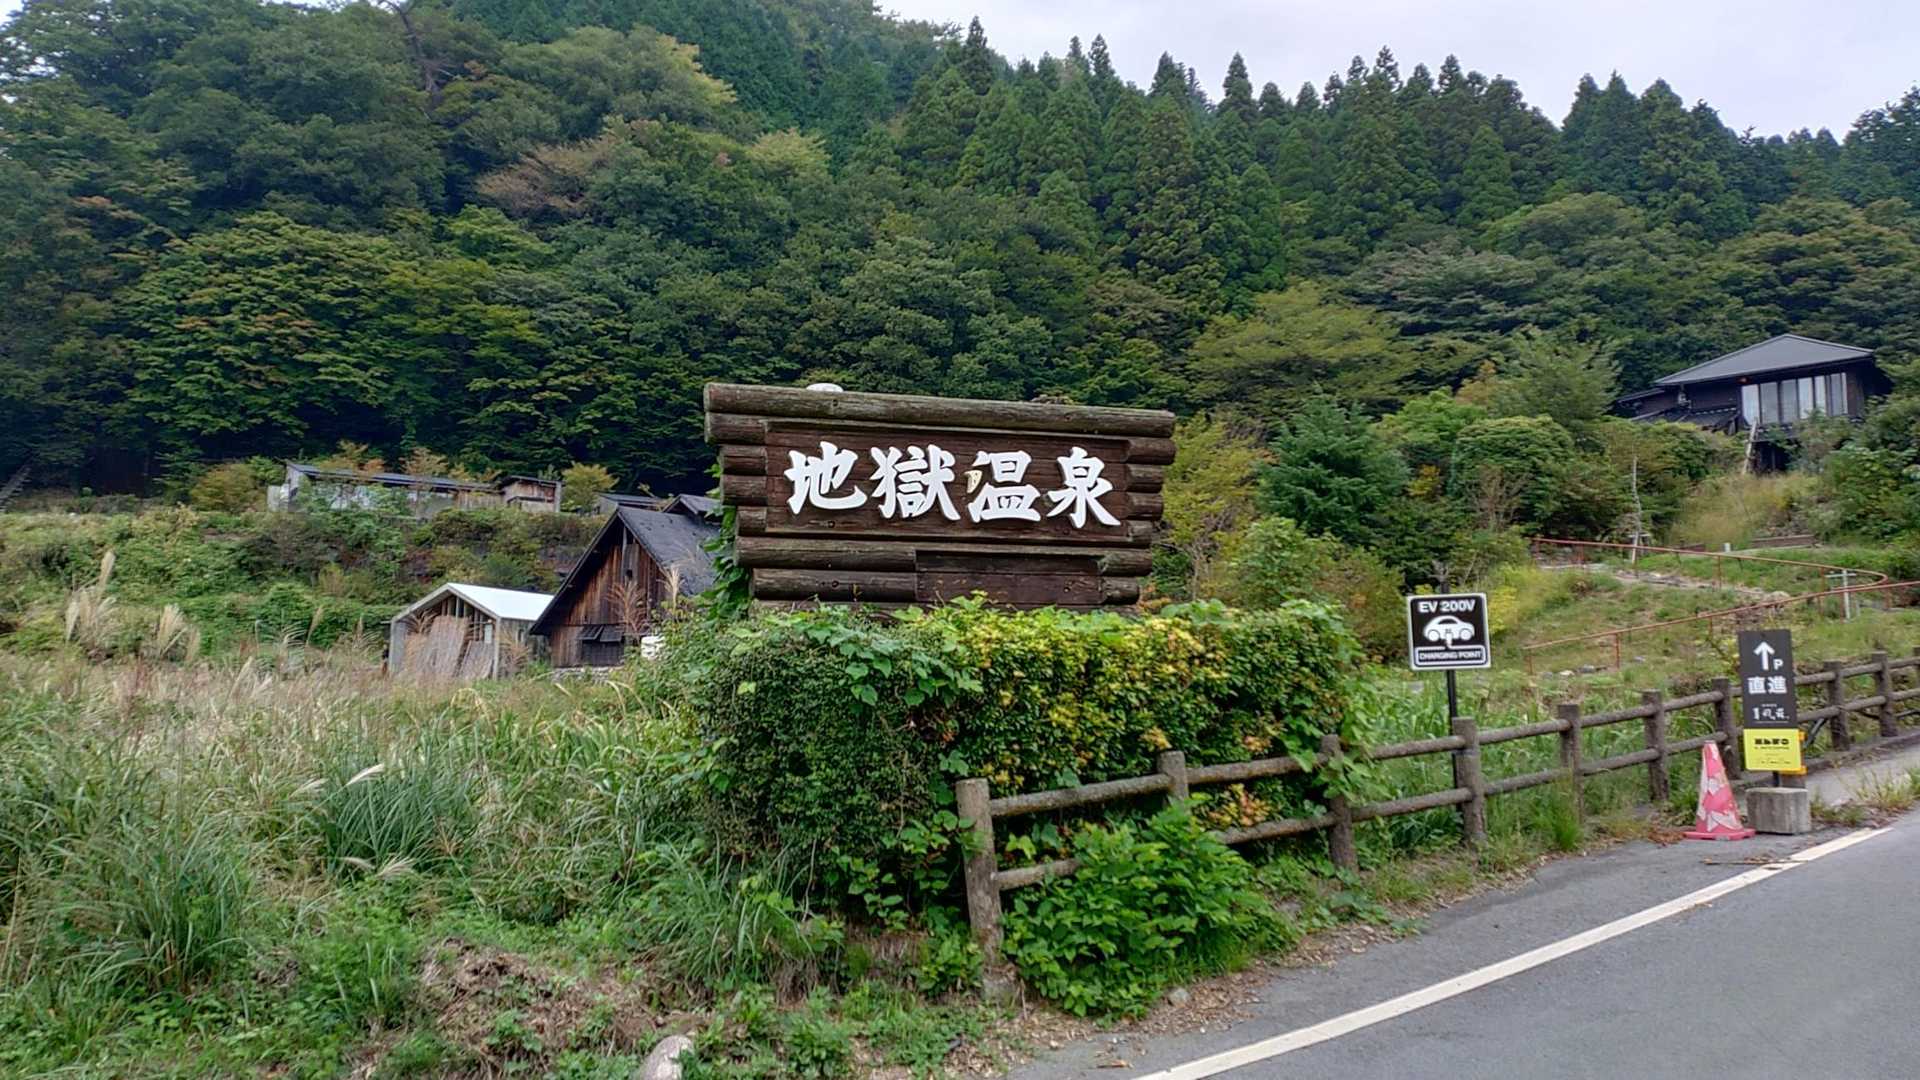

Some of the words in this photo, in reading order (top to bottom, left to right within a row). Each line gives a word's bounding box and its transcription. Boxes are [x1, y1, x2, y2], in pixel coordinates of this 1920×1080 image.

[784, 441, 1121, 529] 地獄温泉
[1418, 601, 1438, 613] EV
[1440, 599, 1476, 612] 200V
[1458, 650, 1482, 659] POINT
[1773, 659, 1784, 670] P
[1747, 675, 1788, 694] 直進
